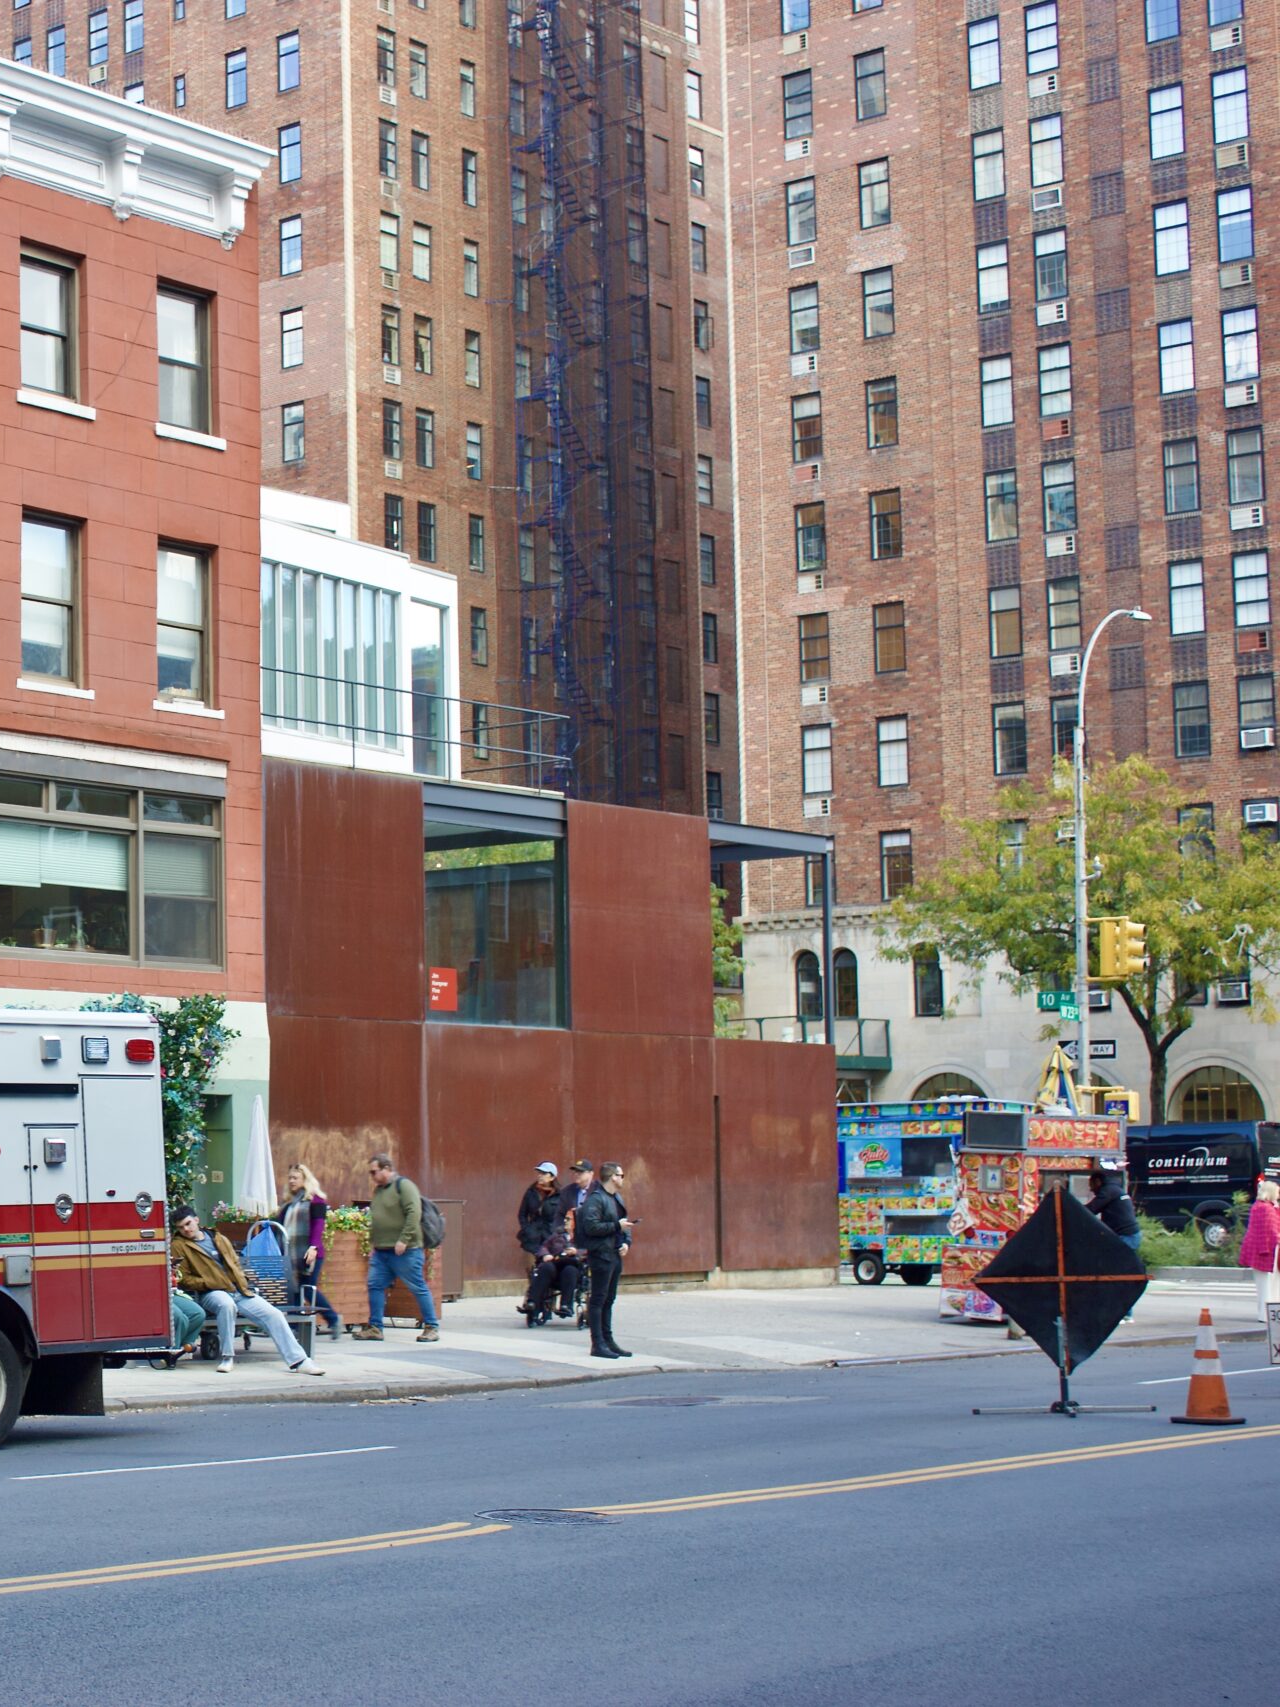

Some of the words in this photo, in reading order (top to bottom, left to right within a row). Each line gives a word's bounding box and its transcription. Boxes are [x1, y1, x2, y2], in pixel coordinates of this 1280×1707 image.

[1041, 993, 1055, 1006] 10
[1060, 993, 1071, 1001] Av
[1092, 1045, 1110, 1053] WAY
[1148, 1154, 1228, 1169] continuum
[990, 1173, 998, 1182] A
[111, 1243, 156, 1254] nyc.gov/fdny
